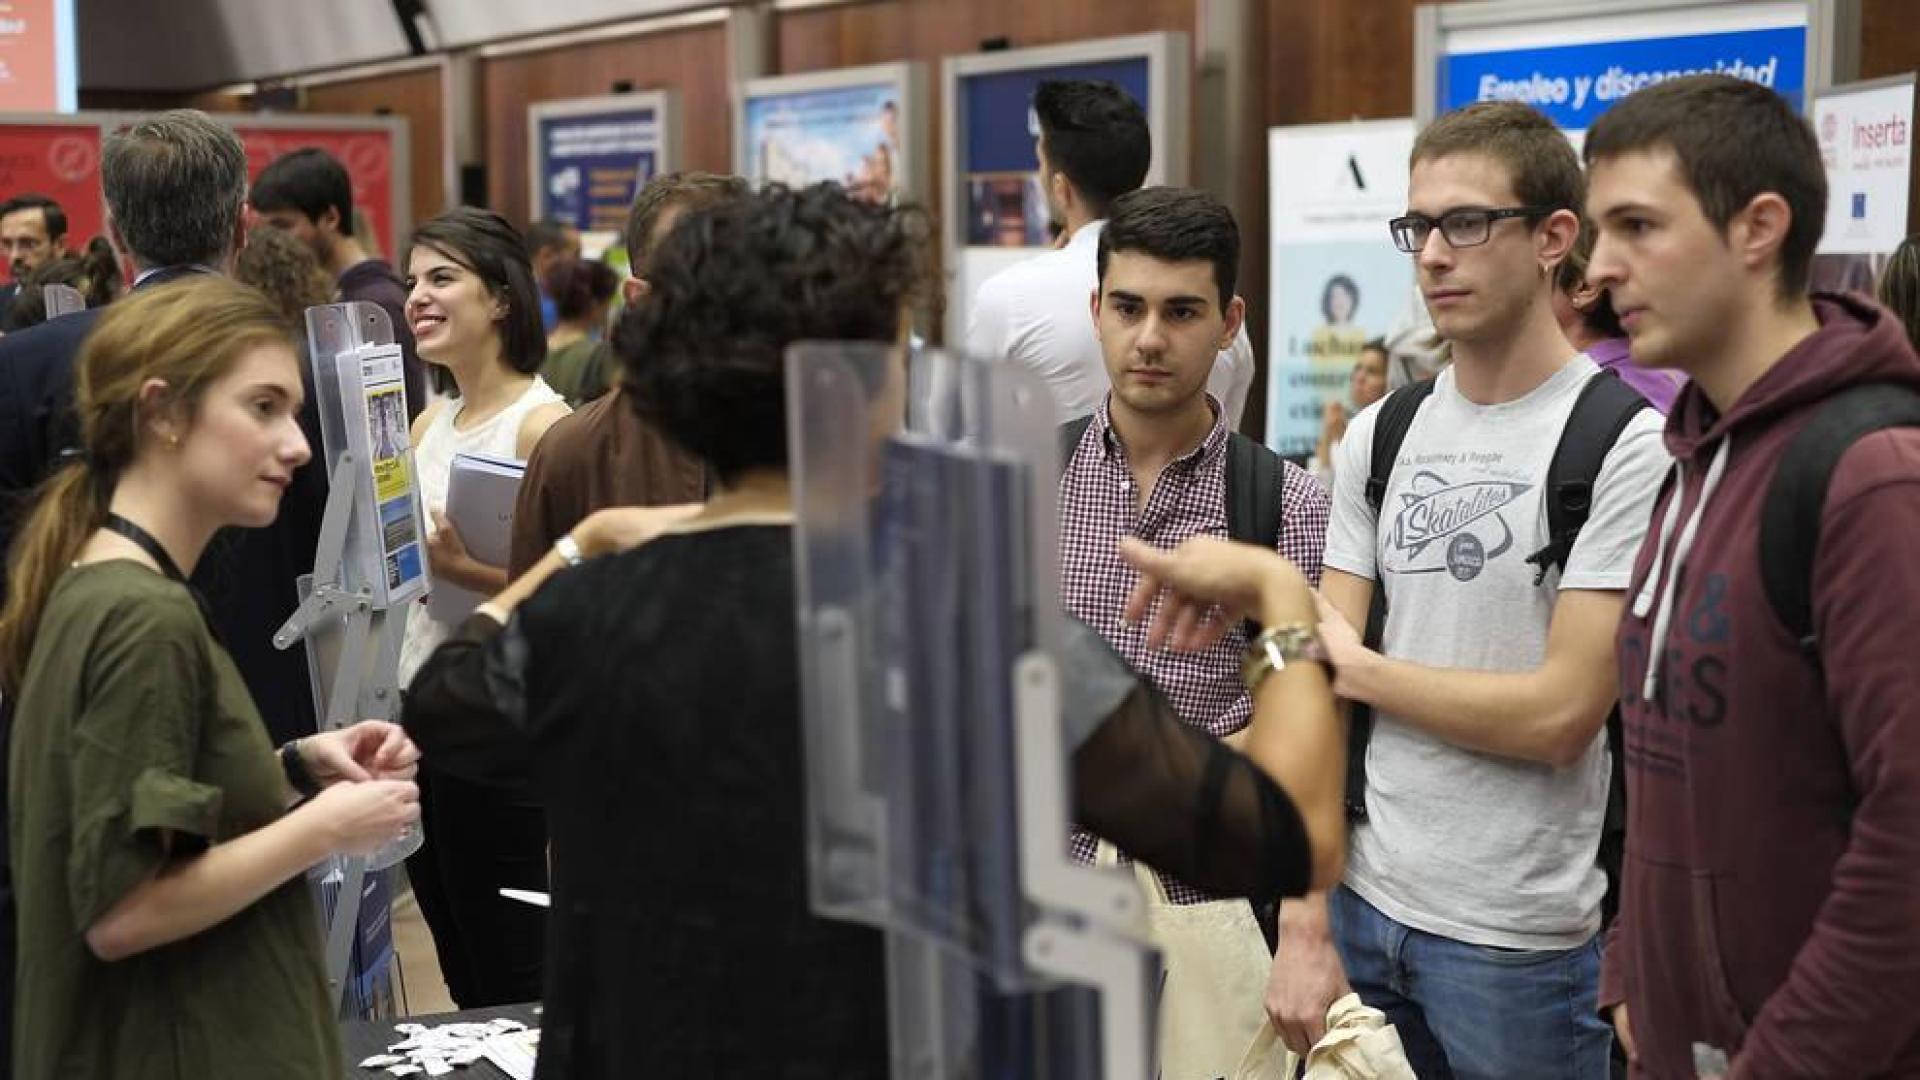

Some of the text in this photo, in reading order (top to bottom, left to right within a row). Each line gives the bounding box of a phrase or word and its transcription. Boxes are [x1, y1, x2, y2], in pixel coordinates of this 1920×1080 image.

[1478, 56, 1777, 110] Empleo y discidad
[1853, 113, 1906, 149] Inserta
[1409, 486, 1507, 535] Skatalites
